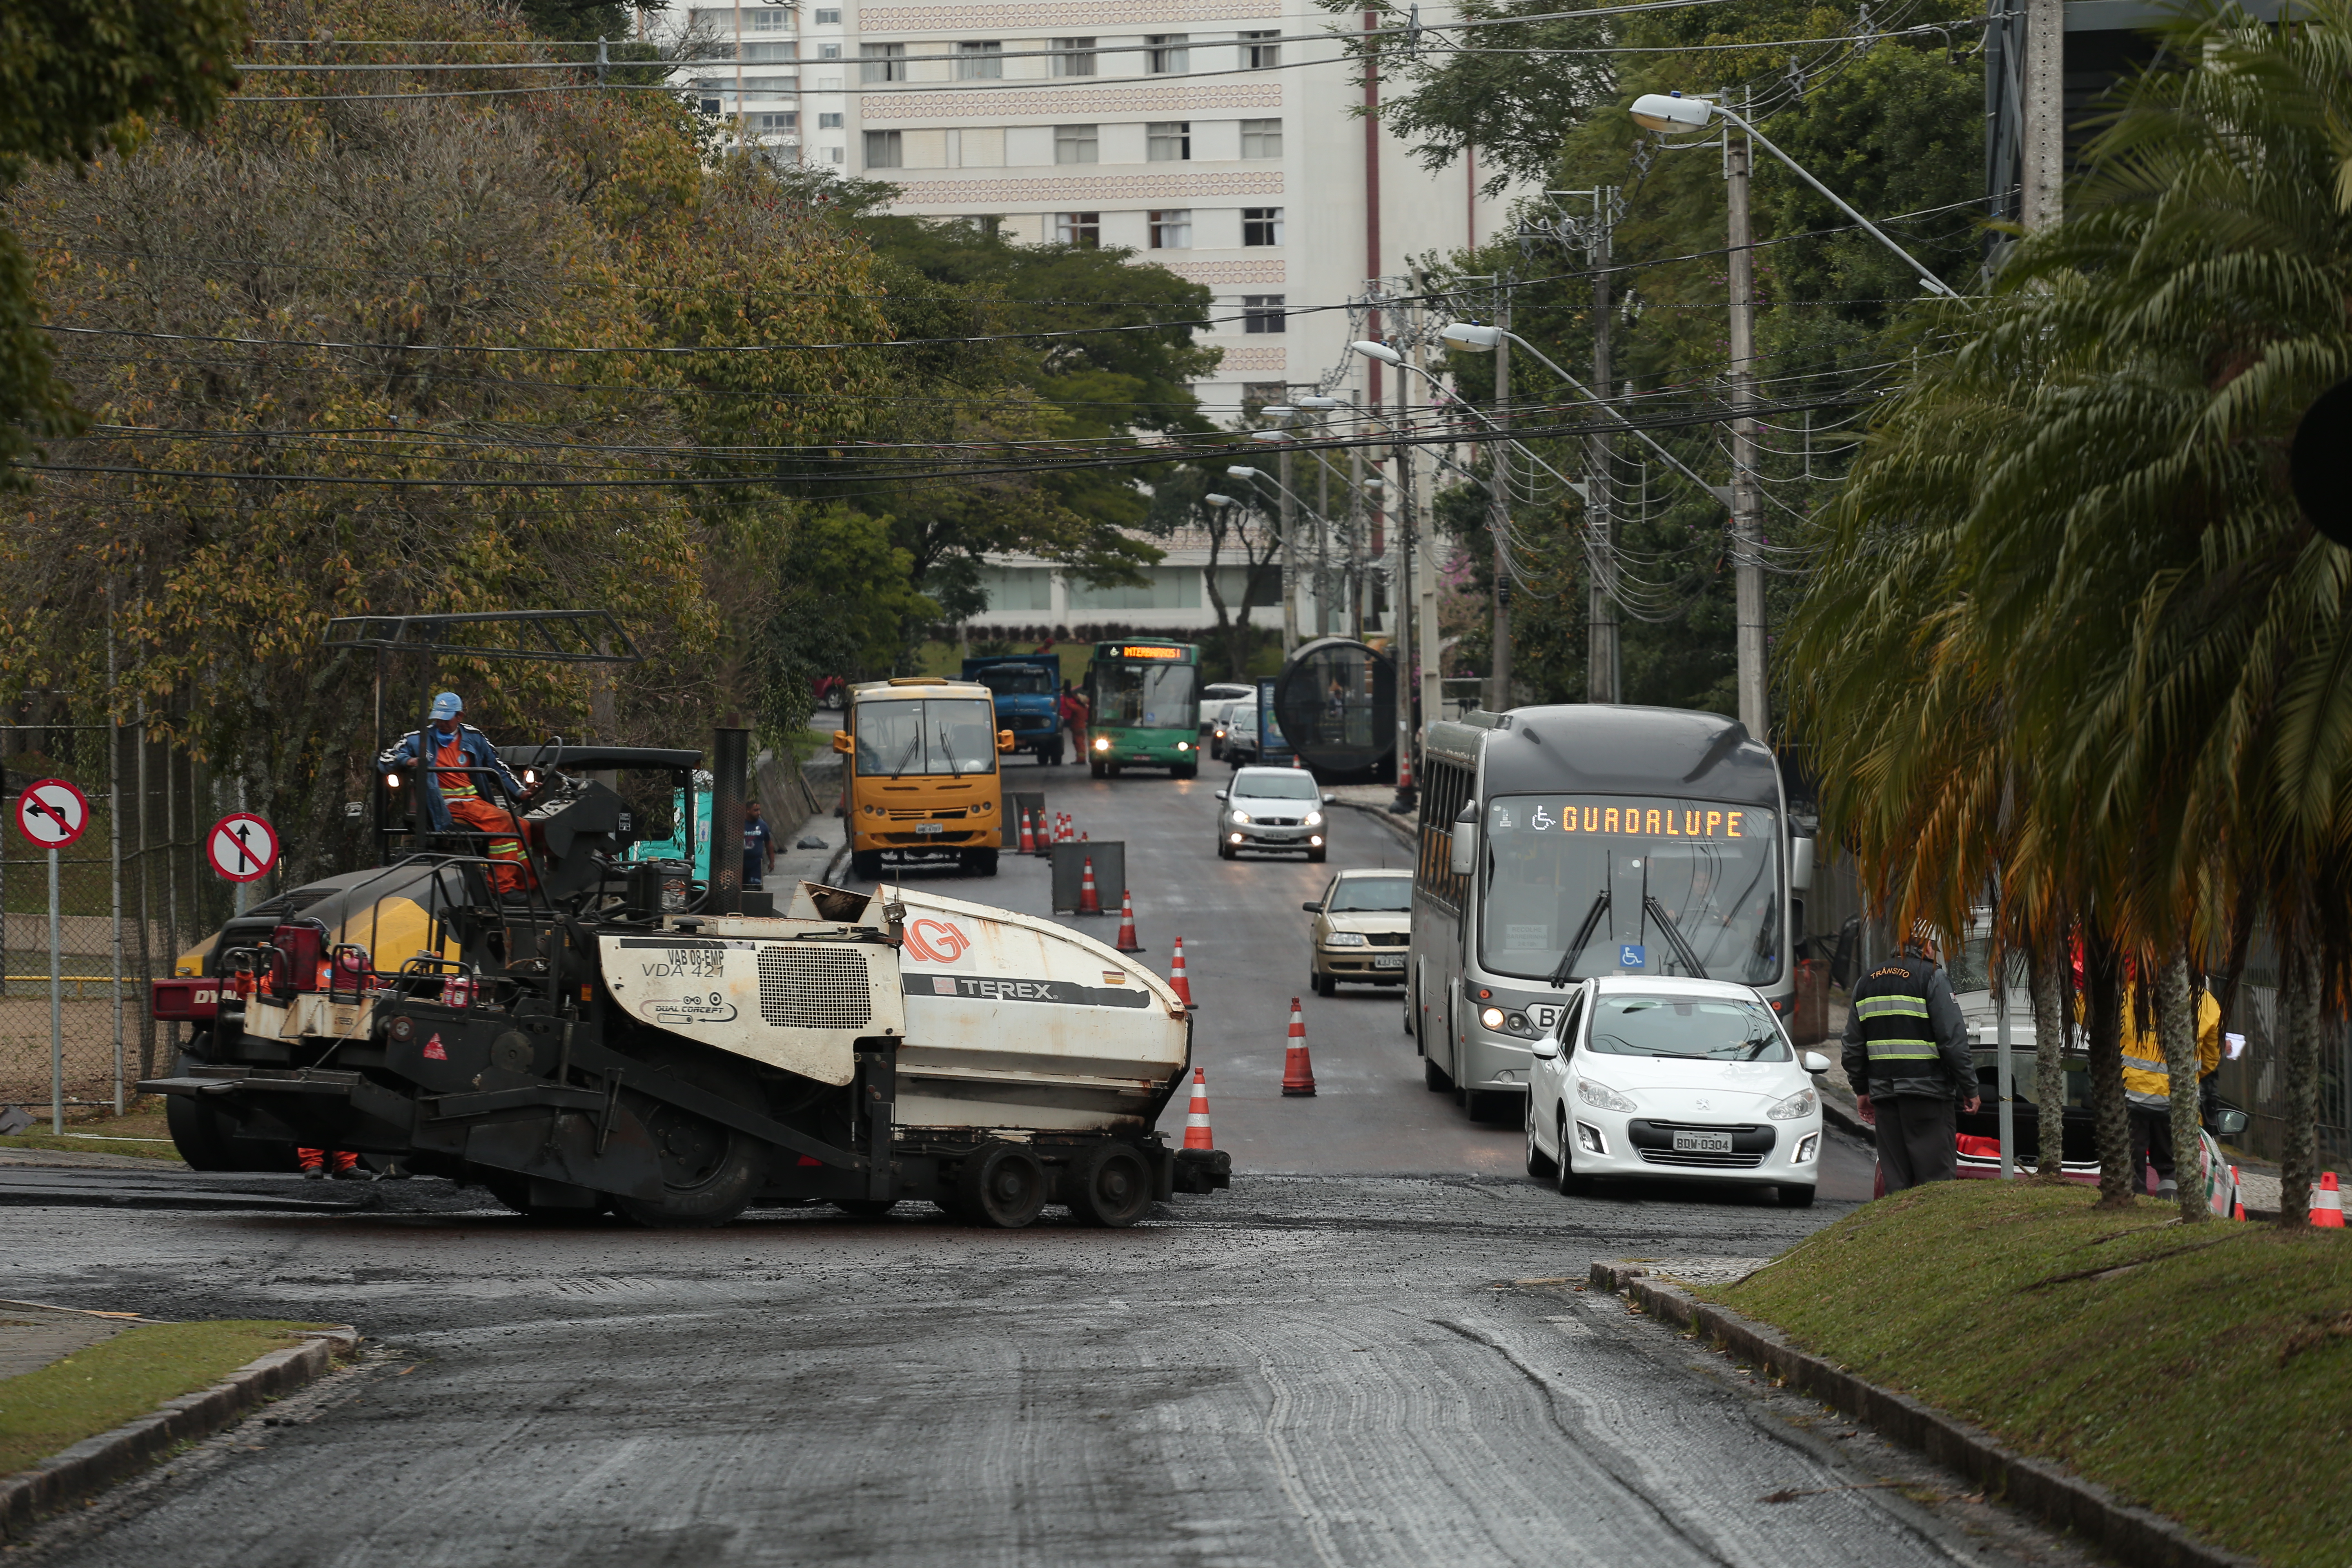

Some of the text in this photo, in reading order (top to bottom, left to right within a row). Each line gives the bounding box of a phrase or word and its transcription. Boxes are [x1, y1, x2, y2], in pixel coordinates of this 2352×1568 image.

[1562, 806, 1742, 837] GUADALUPE
[668, 949, 687, 965] VAB
[642, 964, 724, 978] VDA 421
[1870, 967, 1910, 979] TRÂNSITO
[960, 979, 1054, 1000] TEREX
